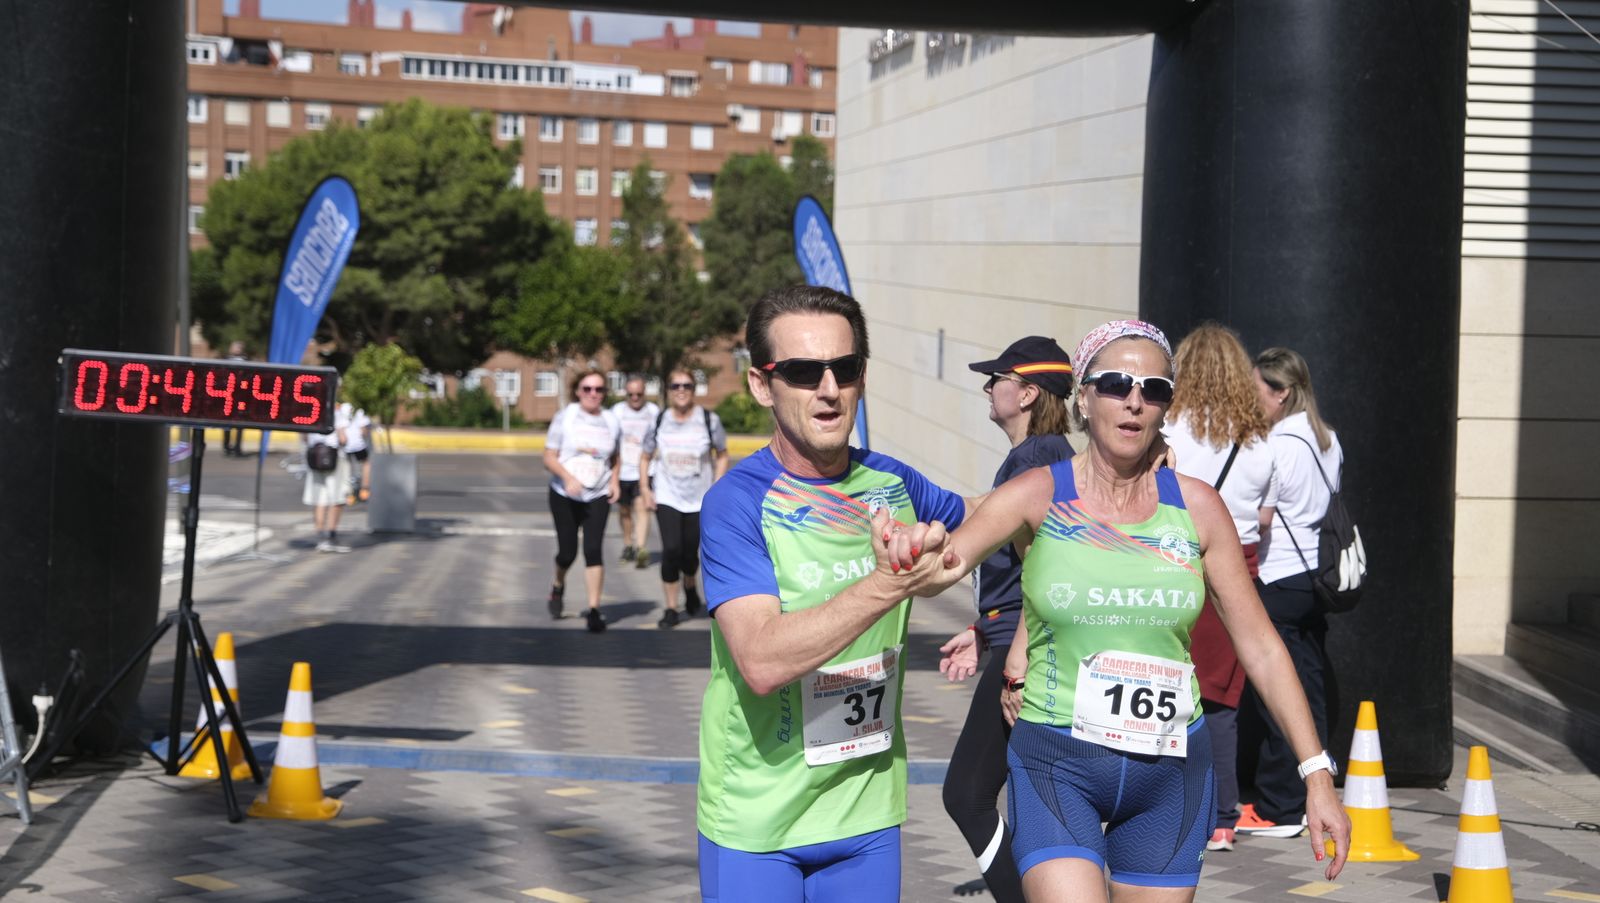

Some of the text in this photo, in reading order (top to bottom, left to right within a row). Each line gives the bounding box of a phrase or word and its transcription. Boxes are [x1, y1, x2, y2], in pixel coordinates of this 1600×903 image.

[832, 555, 876, 582] SAK
[1087, 587, 1197, 609] SAKATA
[1135, 616, 1145, 625] in
[1149, 615, 1179, 627] Seed
[823, 666, 865, 685] CARRERA
[867, 662, 882, 675] SIN
[1102, 657, 1147, 673] CARRERA
[1149, 663, 1163, 676] SIN
[1100, 673, 1122, 682] MUNDIAL
[1134, 679, 1152, 687] TABACO
[844, 685, 885, 726] 37
[1044, 693, 1056, 726] Run
[1104, 683, 1177, 722] 165
[862, 720, 884, 734] SILVA
[1123, 719, 1157, 733] CONCHI
